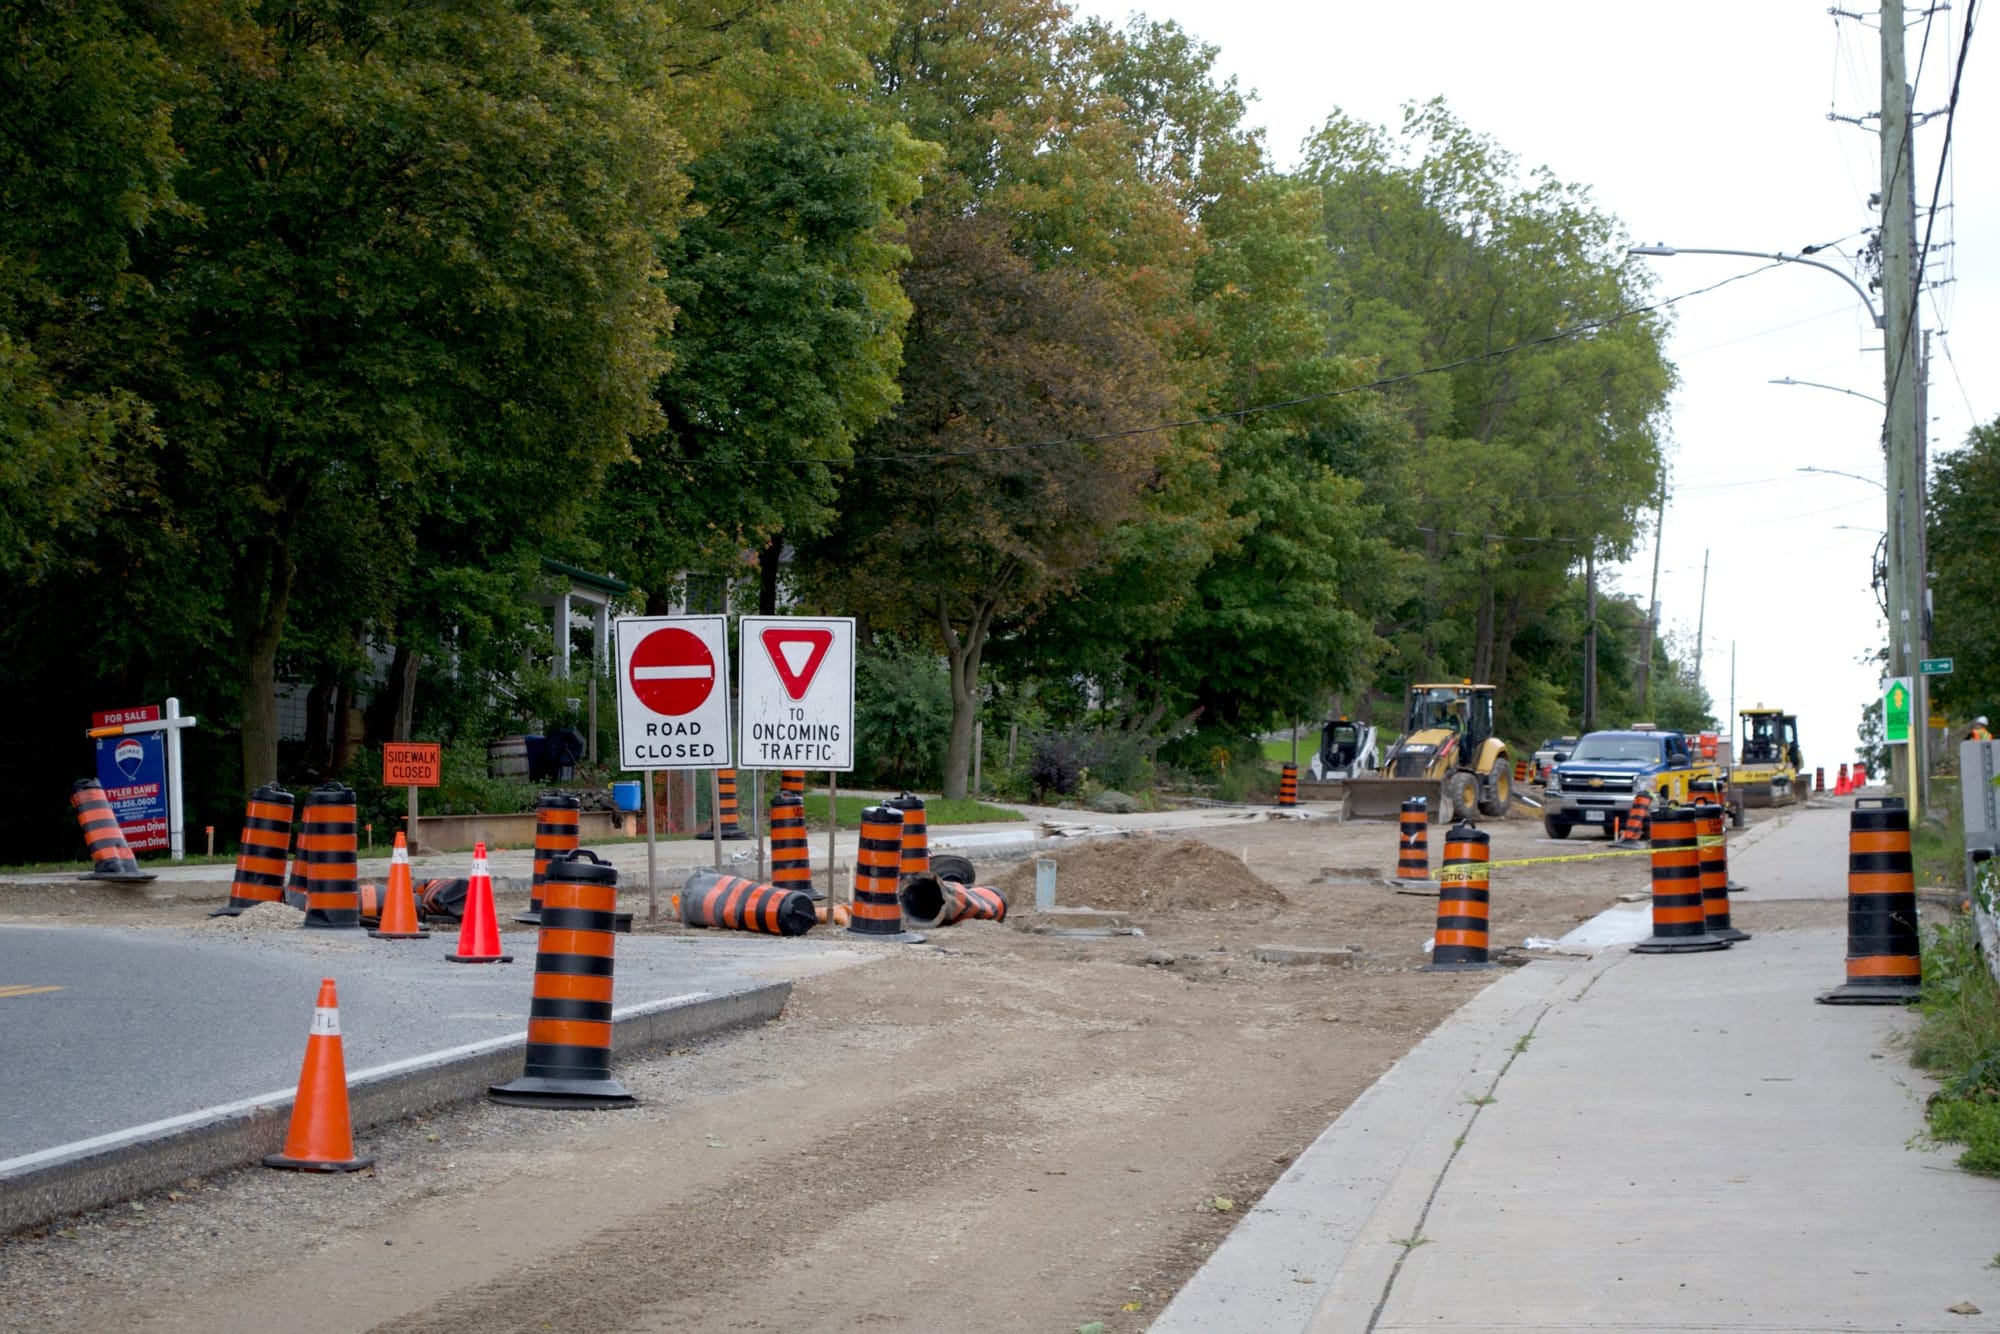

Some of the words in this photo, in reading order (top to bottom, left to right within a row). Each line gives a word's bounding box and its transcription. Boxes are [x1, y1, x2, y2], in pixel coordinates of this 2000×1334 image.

[104, 713, 122, 724] FOR
[124, 710, 147, 722] SALE
[789, 708, 804, 721] TO
[646, 722, 702, 736] ROAD
[753, 723, 840, 741] ONCOMING
[635, 744, 715, 759] CLOSED
[761, 744, 832, 760] TRAFFIC
[1406, 744, 1429, 753] CAT
[388, 751, 436, 763] SIDEWALK
[392, 765, 431, 778] CLOSED
[107, 786, 132, 798] TYLER
[133, 783, 158, 795] DAWE
[147, 822, 166, 832] Drive
[148, 837, 167, 847] Drive
